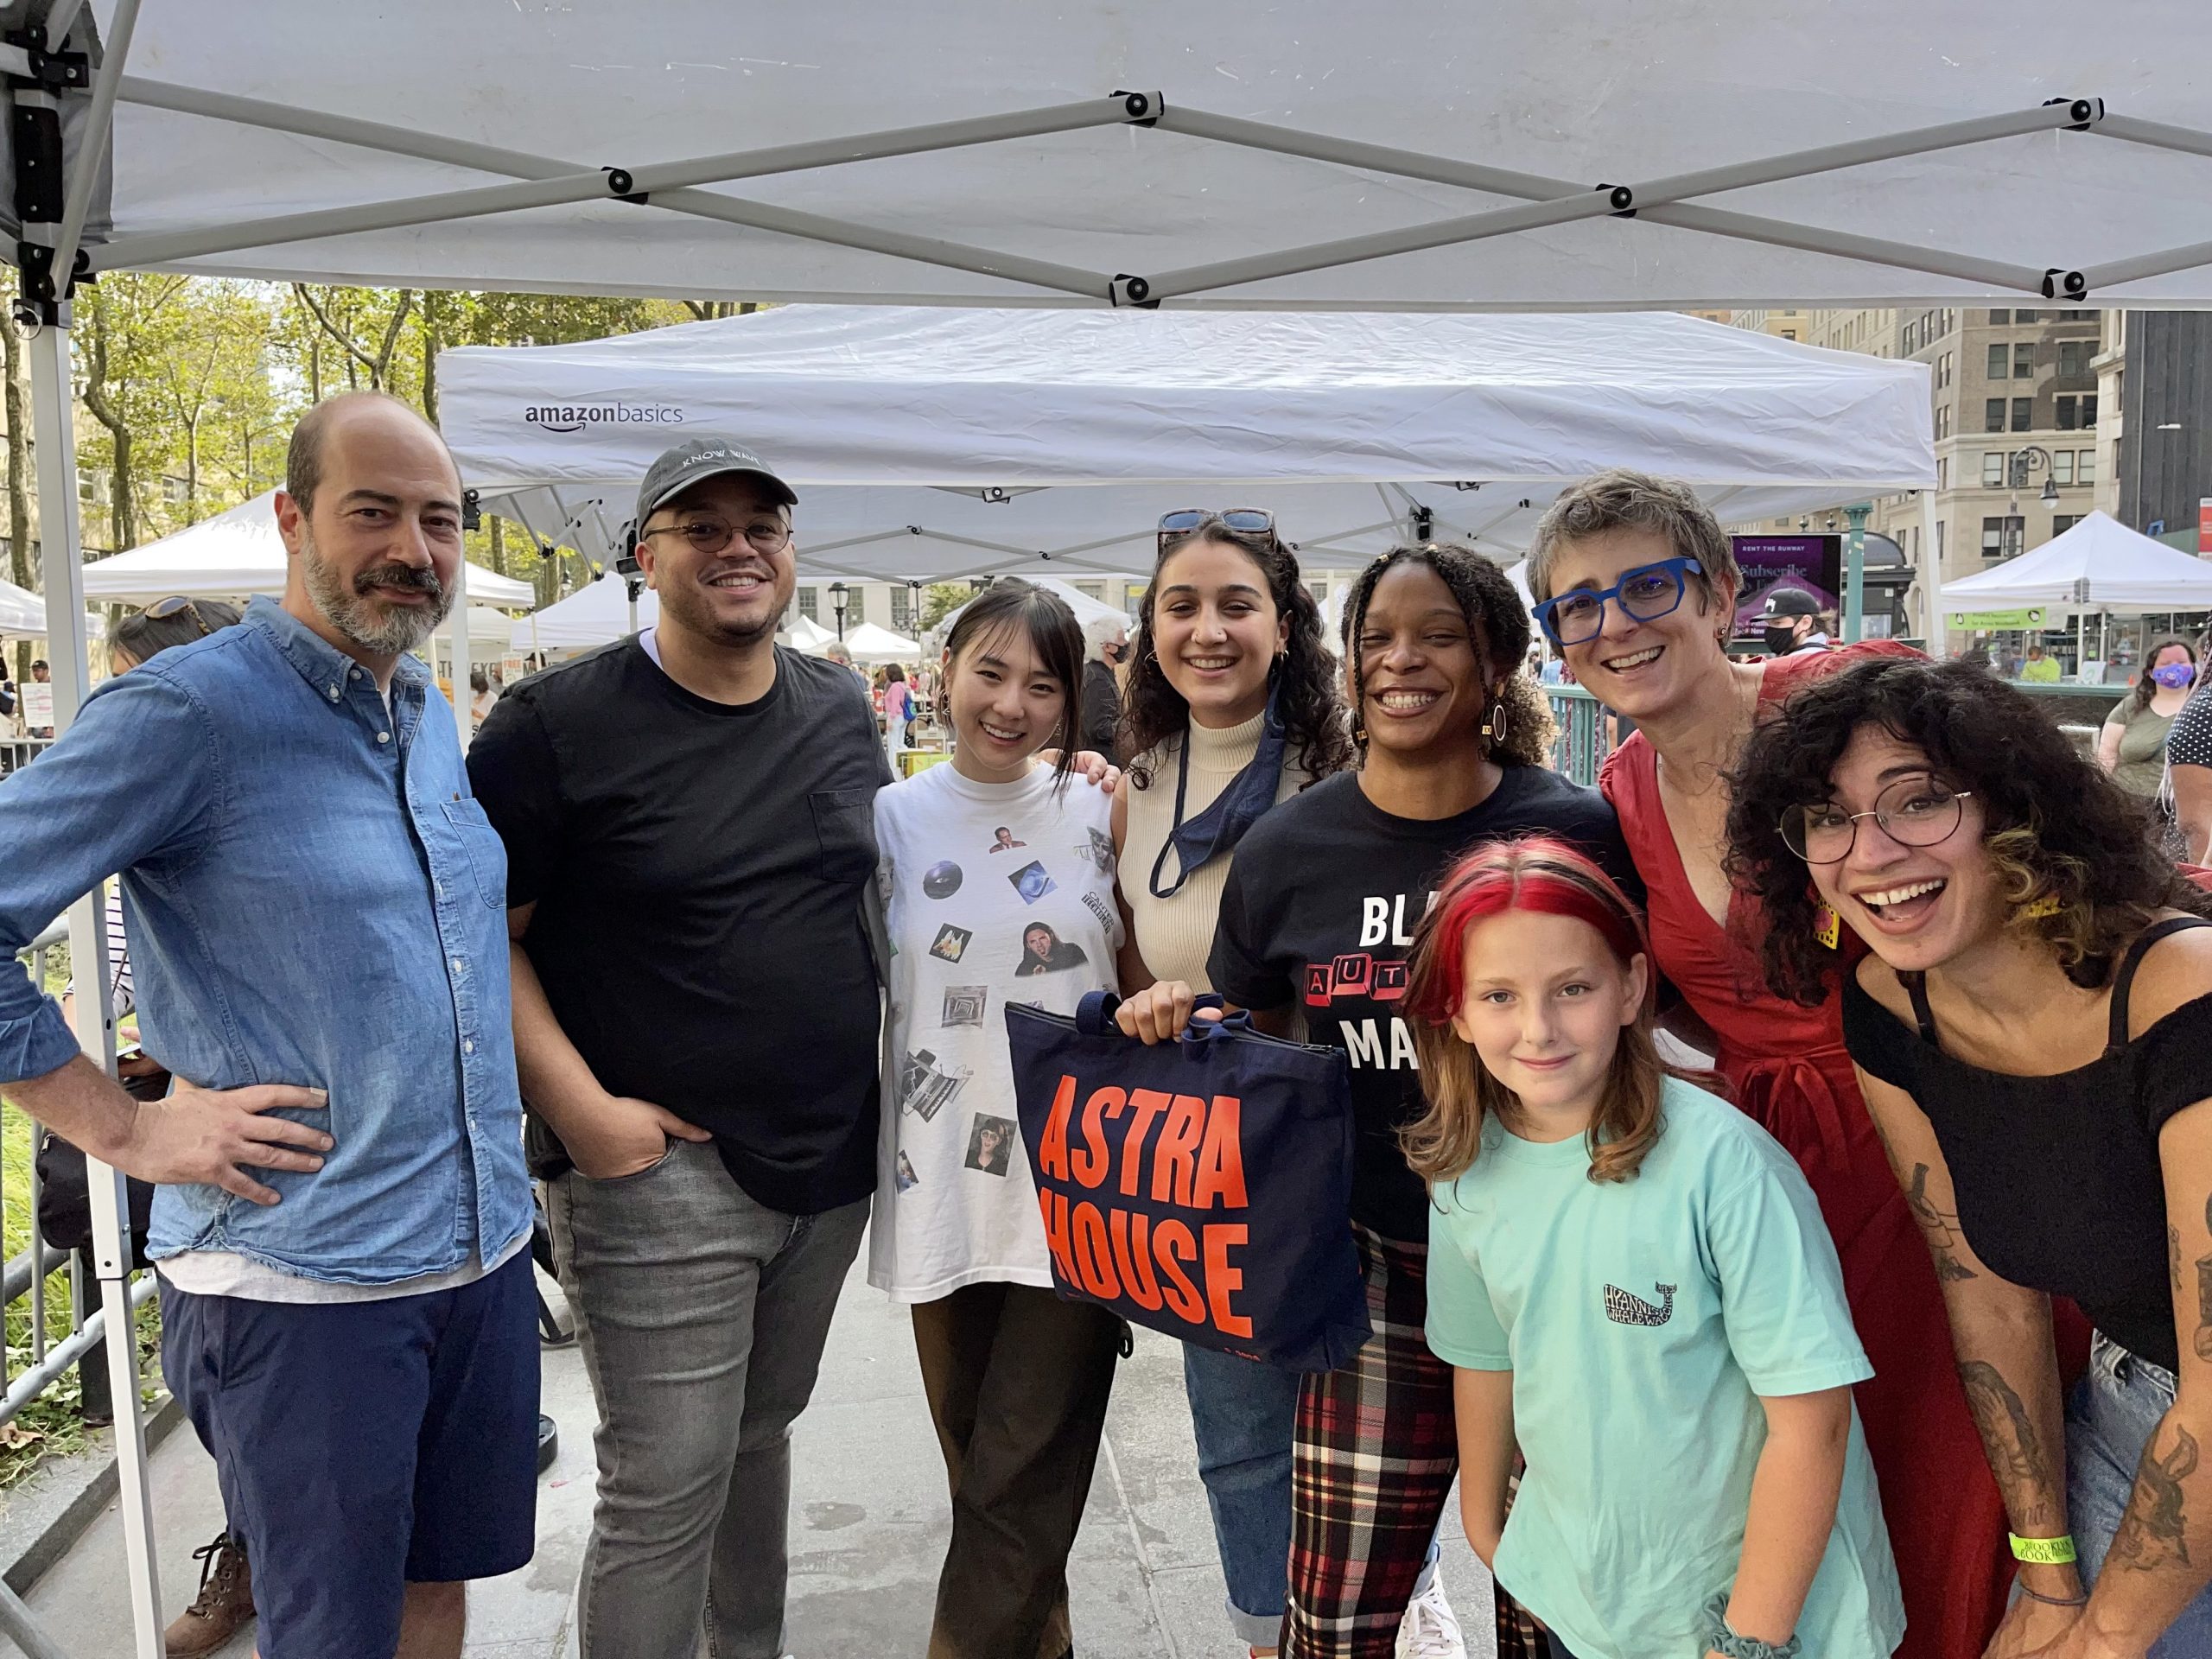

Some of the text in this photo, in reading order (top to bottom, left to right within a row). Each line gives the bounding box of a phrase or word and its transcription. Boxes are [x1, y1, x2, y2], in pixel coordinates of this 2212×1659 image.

[525, 403, 683, 423] amazonbasics
[682, 449, 726, 467] KNOW
[1740, 564, 1807, 577] Subscribe
[1039, 1074, 1249, 1209] ASTRA
[1039, 1186, 1253, 1338] HOUSE
[1607, 1306, 1643, 1325] WHALE
[2021, 1549, 2053, 1561] BOOK
